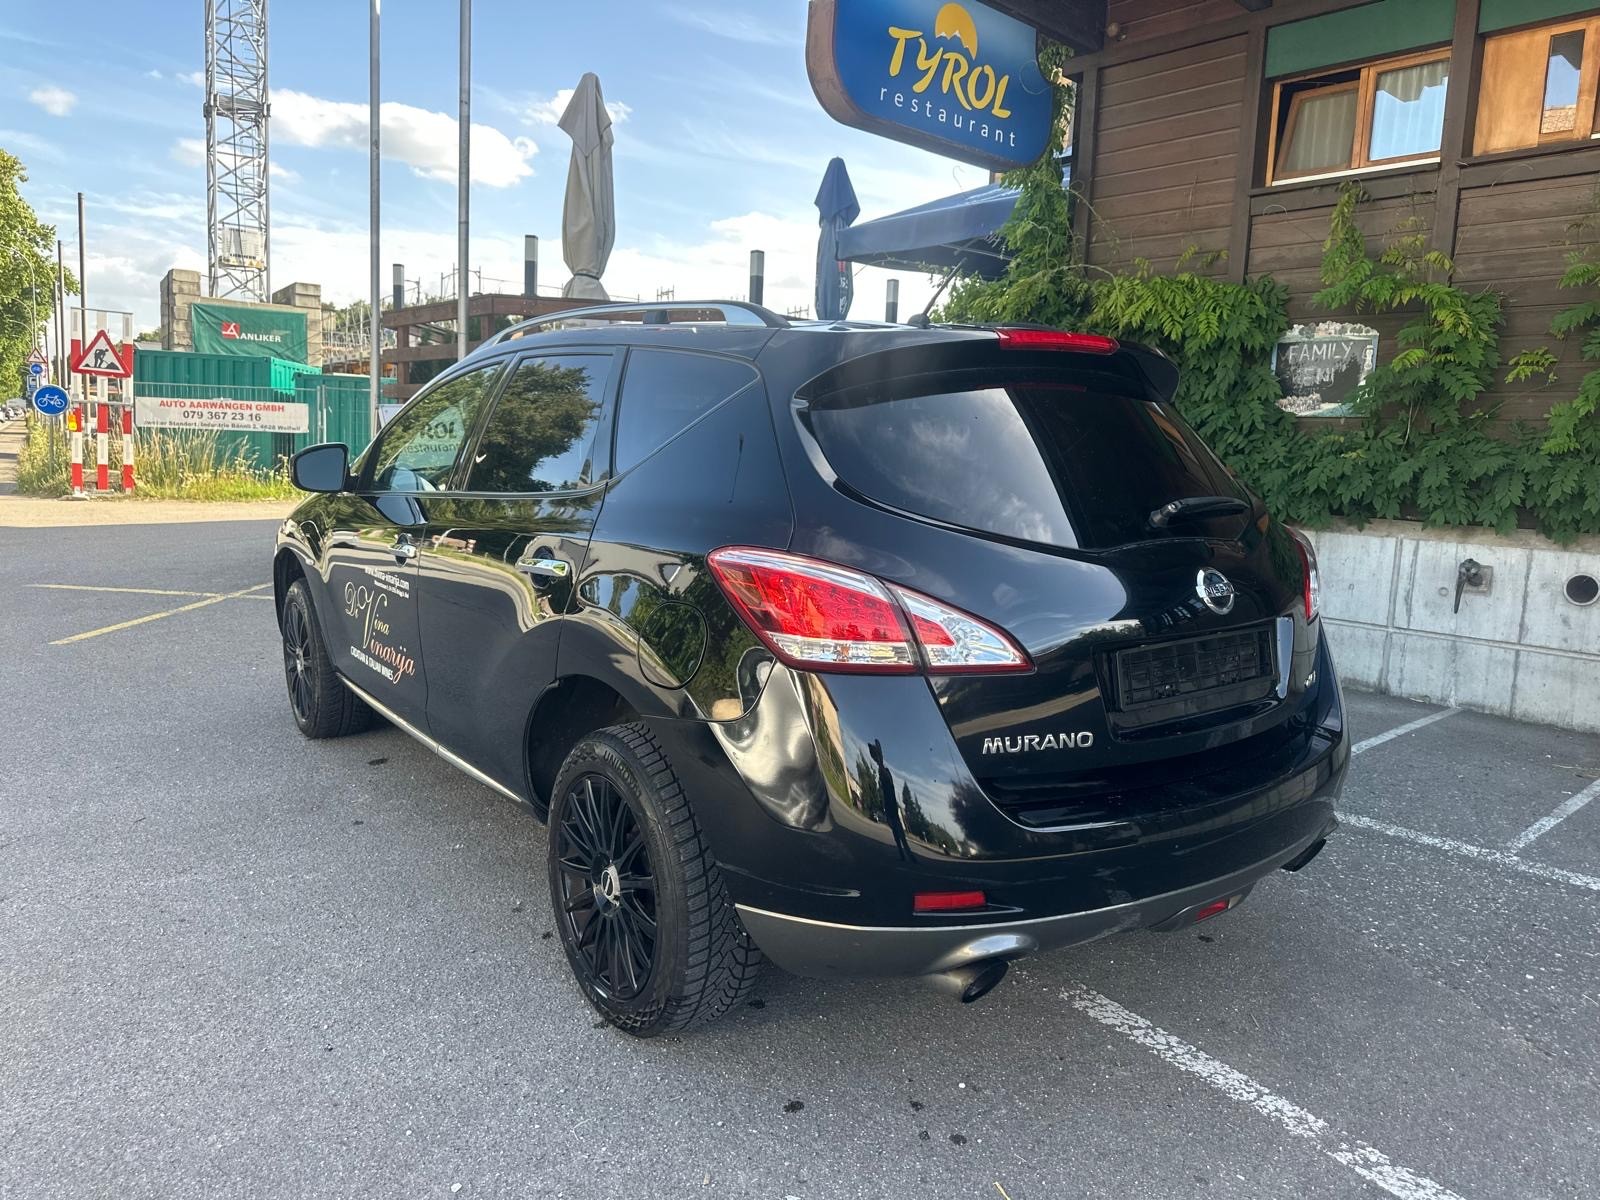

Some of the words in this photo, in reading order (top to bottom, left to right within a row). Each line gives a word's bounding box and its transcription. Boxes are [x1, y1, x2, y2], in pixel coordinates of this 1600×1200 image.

[888, 26, 1011, 118] TYROL
[880, 87, 1016, 147] restaurant
[240, 332, 281, 342] ANLIKER
[1289, 342, 1354, 363] FAMILY
[159, 400, 186, 408] AUTO
[255, 404, 285, 412] GMBH
[183, 410, 204, 420] 079
[207, 411, 228, 420] 367
[231, 412, 245, 421] 23
[248, 413, 262, 422] 16
[982, 731, 1094, 755] MURANO
